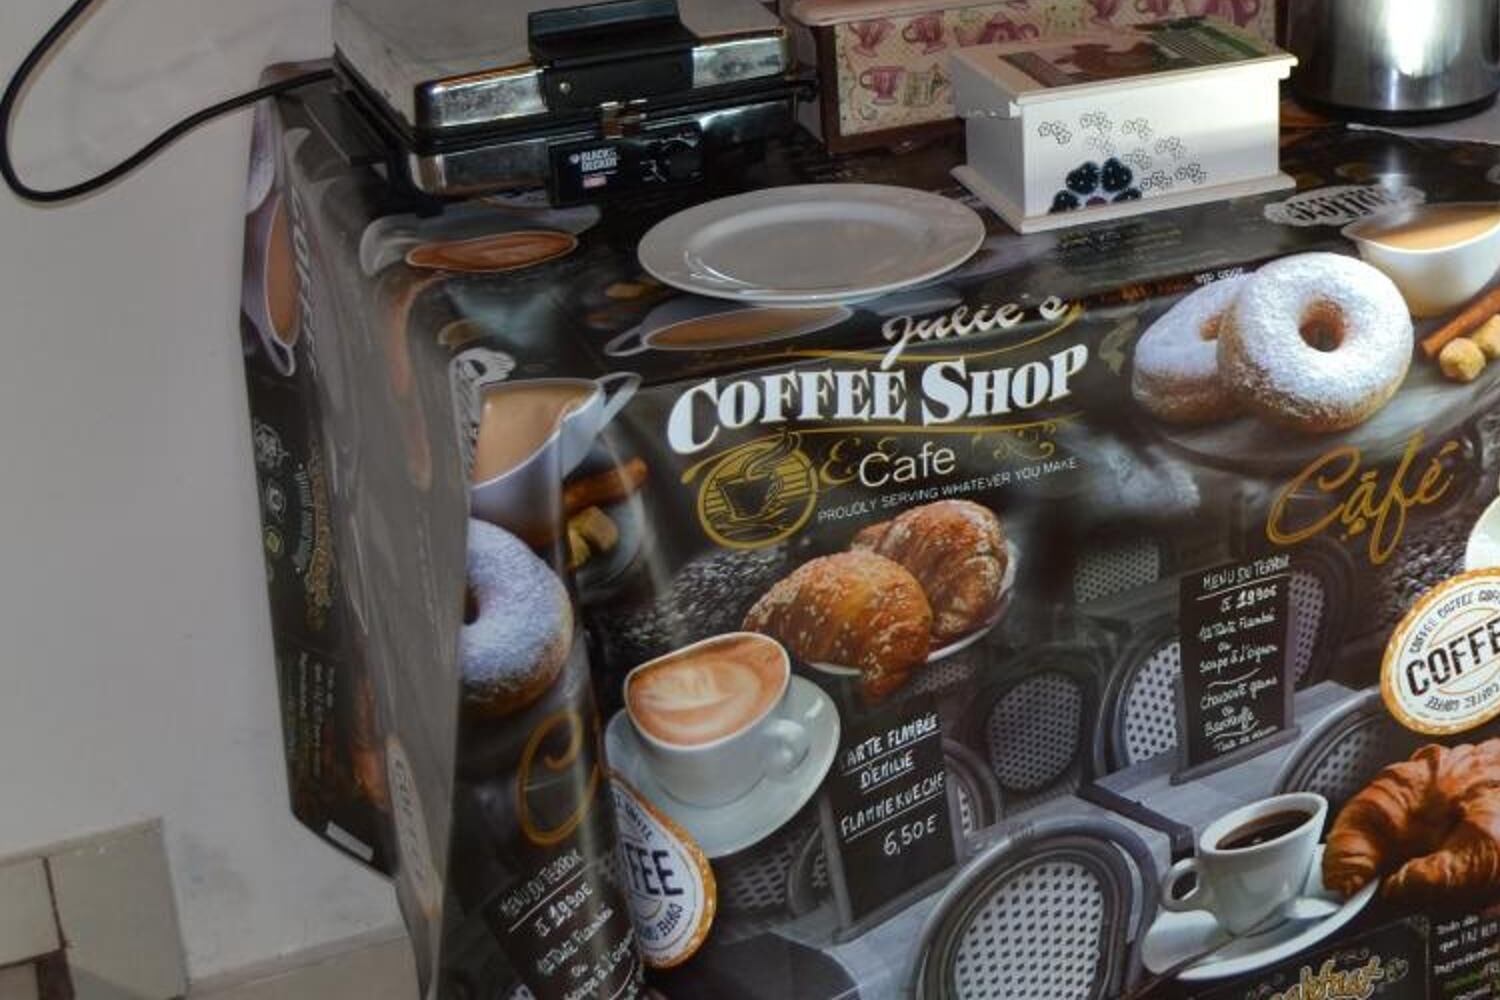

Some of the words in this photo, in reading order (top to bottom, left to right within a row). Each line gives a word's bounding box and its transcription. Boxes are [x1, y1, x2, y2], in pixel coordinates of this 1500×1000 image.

[667, 366, 908, 456] COFFEE
[920, 343, 1089, 428] SHOP
[818, 499, 877, 523] PROUDLY
[881, 485, 939, 509] SERVING
[940, 471, 1013, 497] WHATEVER
[1014, 465, 1041, 481] YOU
[1042, 456, 1077, 474] MAKE
[858, 441, 956, 489] Cafe
[1265, 427, 1461, 565] Café
